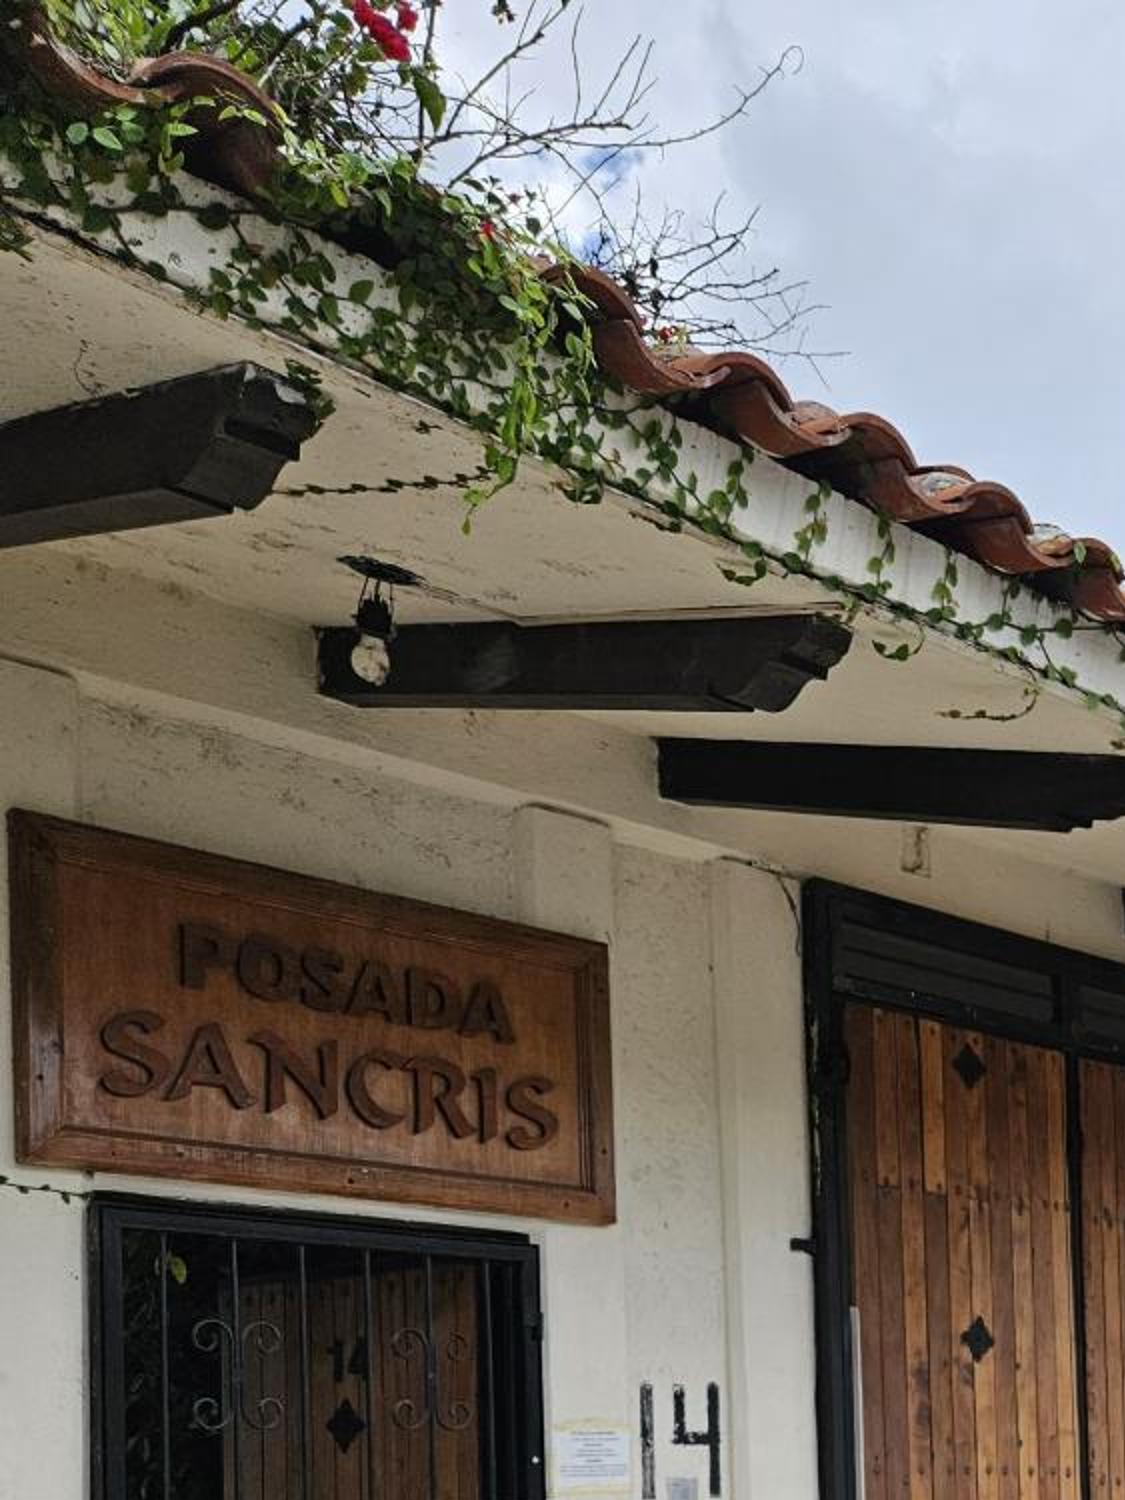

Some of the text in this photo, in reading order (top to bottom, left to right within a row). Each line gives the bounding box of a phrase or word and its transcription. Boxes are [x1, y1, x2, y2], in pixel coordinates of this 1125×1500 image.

[175, 920, 517, 1044] POSADA
[99, 1009, 559, 1150] SANCRIS
[640, 1381, 721, 1500] 14
